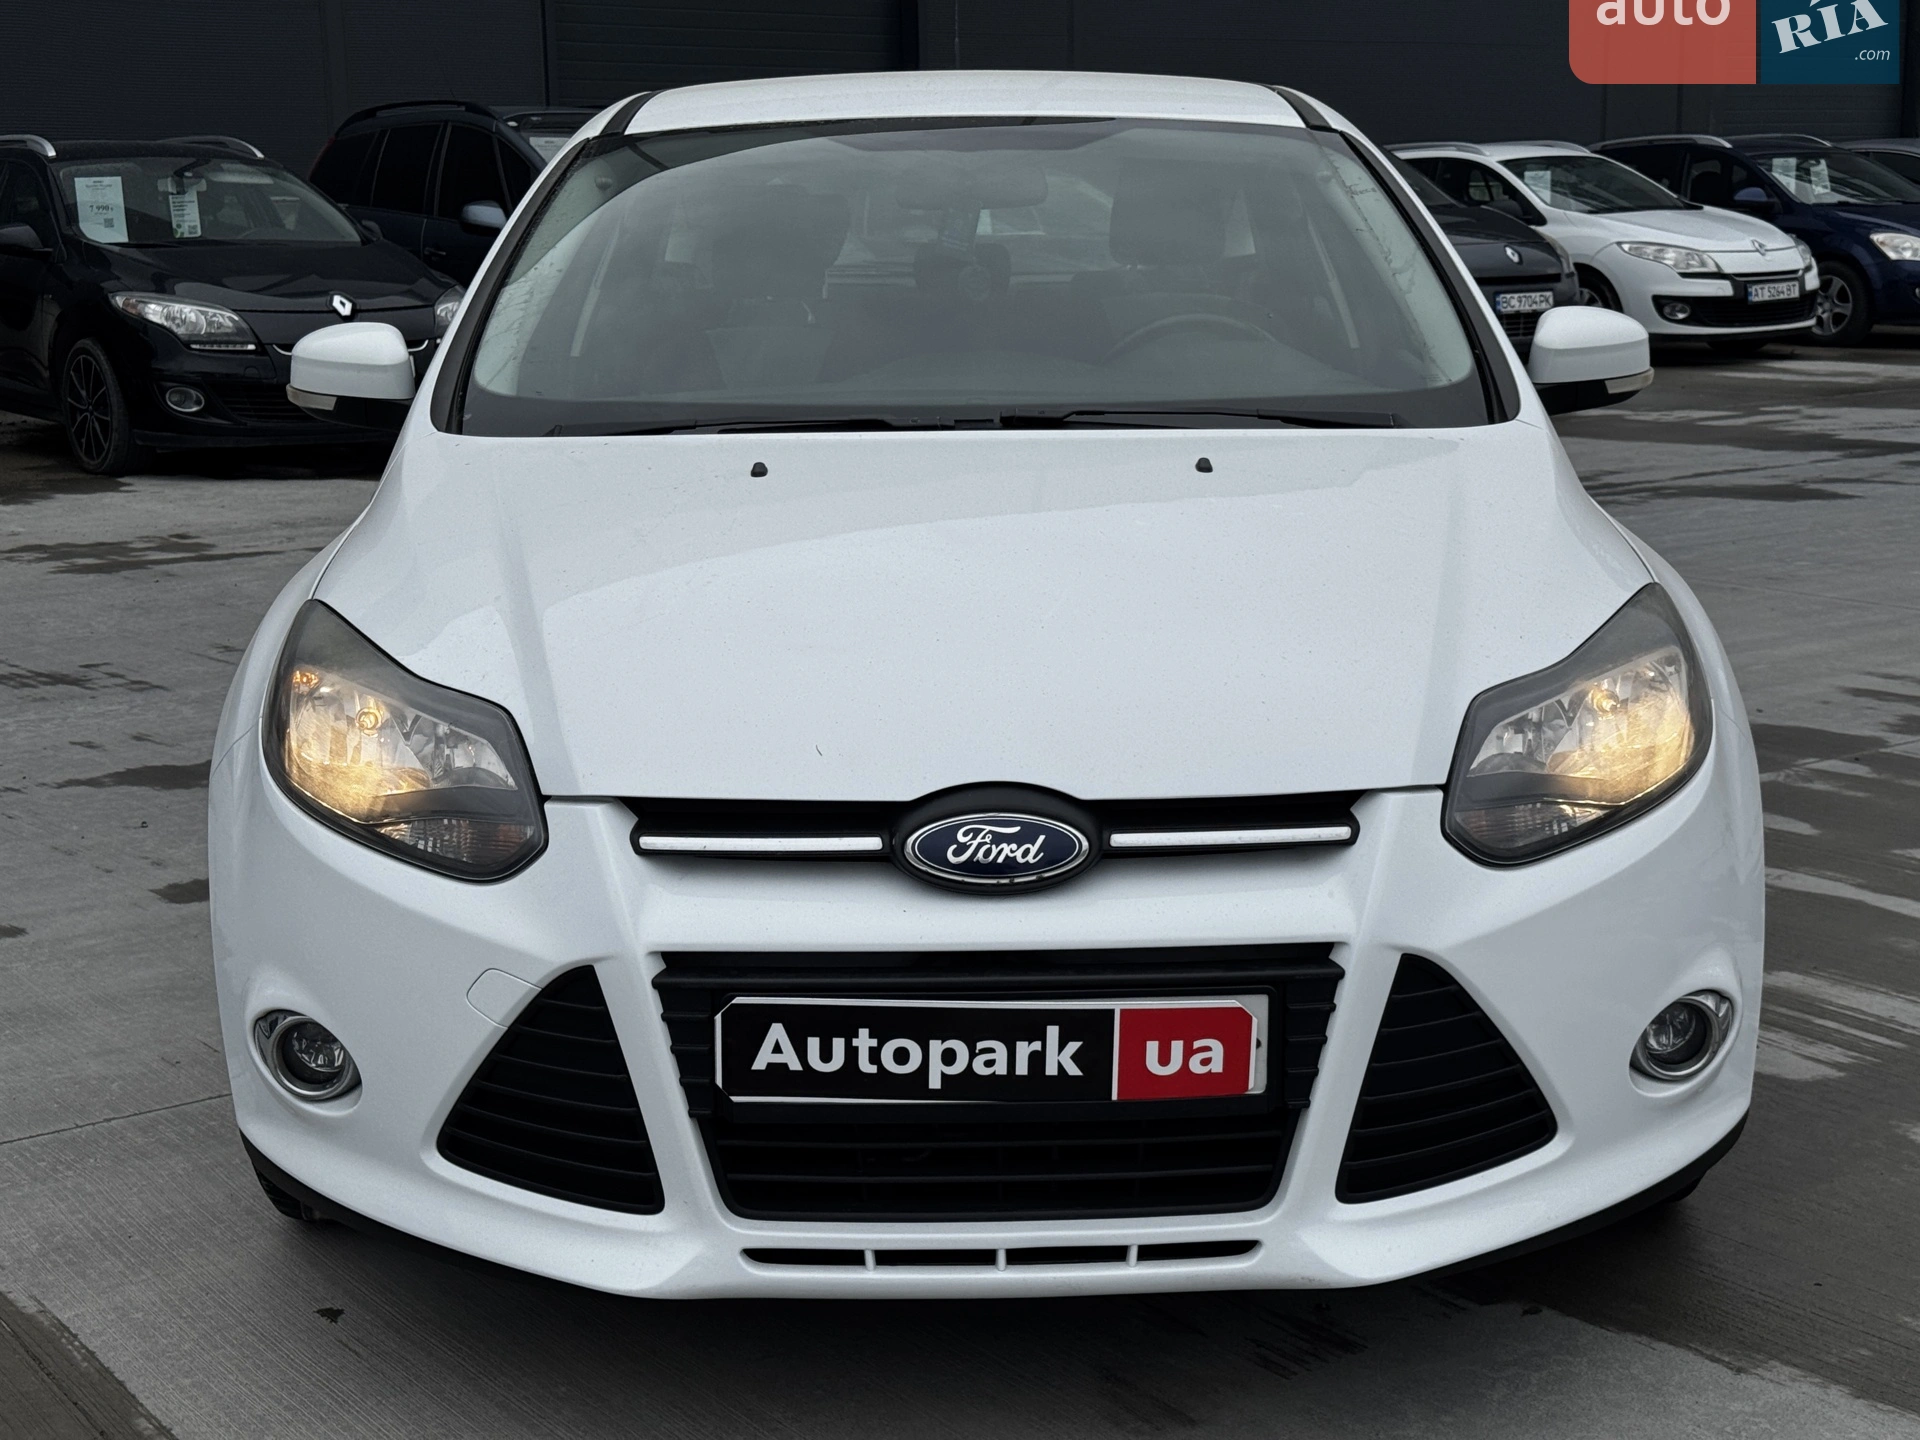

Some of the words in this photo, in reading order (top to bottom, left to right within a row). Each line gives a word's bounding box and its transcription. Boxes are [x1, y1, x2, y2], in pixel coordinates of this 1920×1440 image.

[947, 824, 1046, 864] Ford
[750, 1022, 1084, 1090] Autopark
[1145, 1038, 1225, 1076] ua
